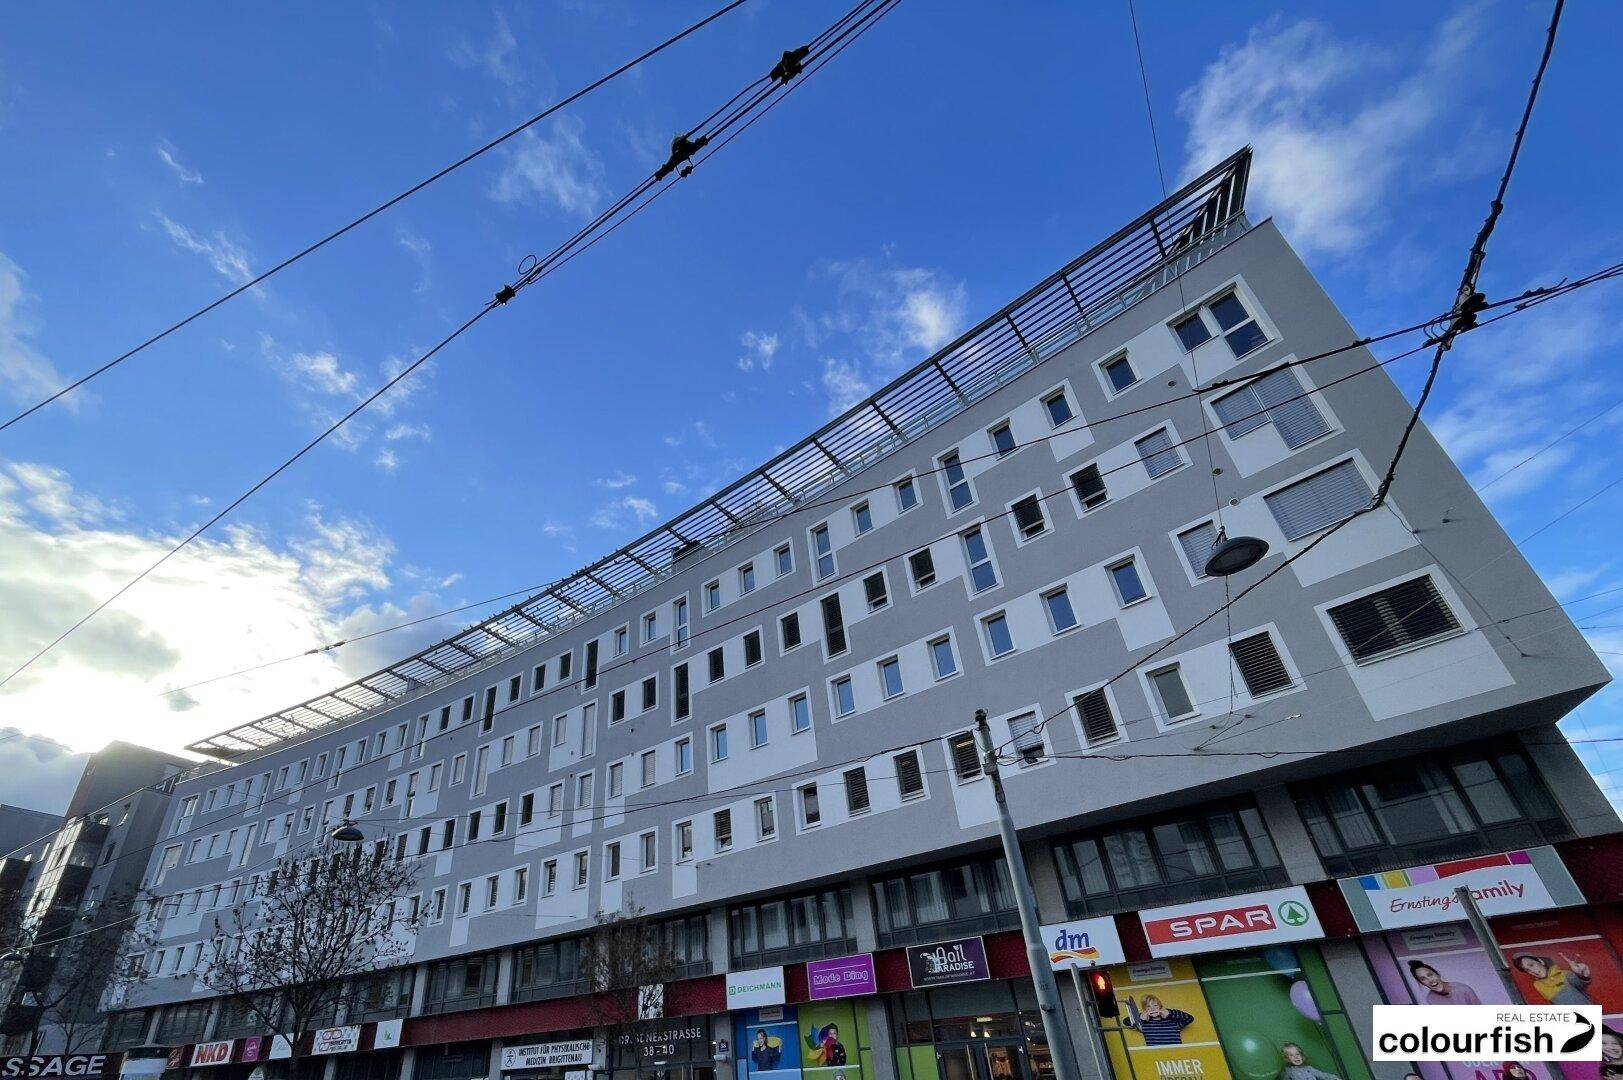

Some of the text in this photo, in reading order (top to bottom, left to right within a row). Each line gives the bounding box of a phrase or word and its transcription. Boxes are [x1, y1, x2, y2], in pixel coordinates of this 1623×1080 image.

[1469, 880, 1524, 901] amily
[1171, 910, 1272, 938] SPAR
[1054, 929, 1090, 951] dm
[813, 973, 841, 985] Mode
[737, 981, 782, 994] DEICHMANN
[195, 1042, 229, 1064] NKD
[518, 1042, 590, 1057] INSTITUT FÜR PHYSIKALISCHE
[525, 1057, 547, 1066] MEDIZIN
[1155, 1059, 1204, 1075] IMMER
